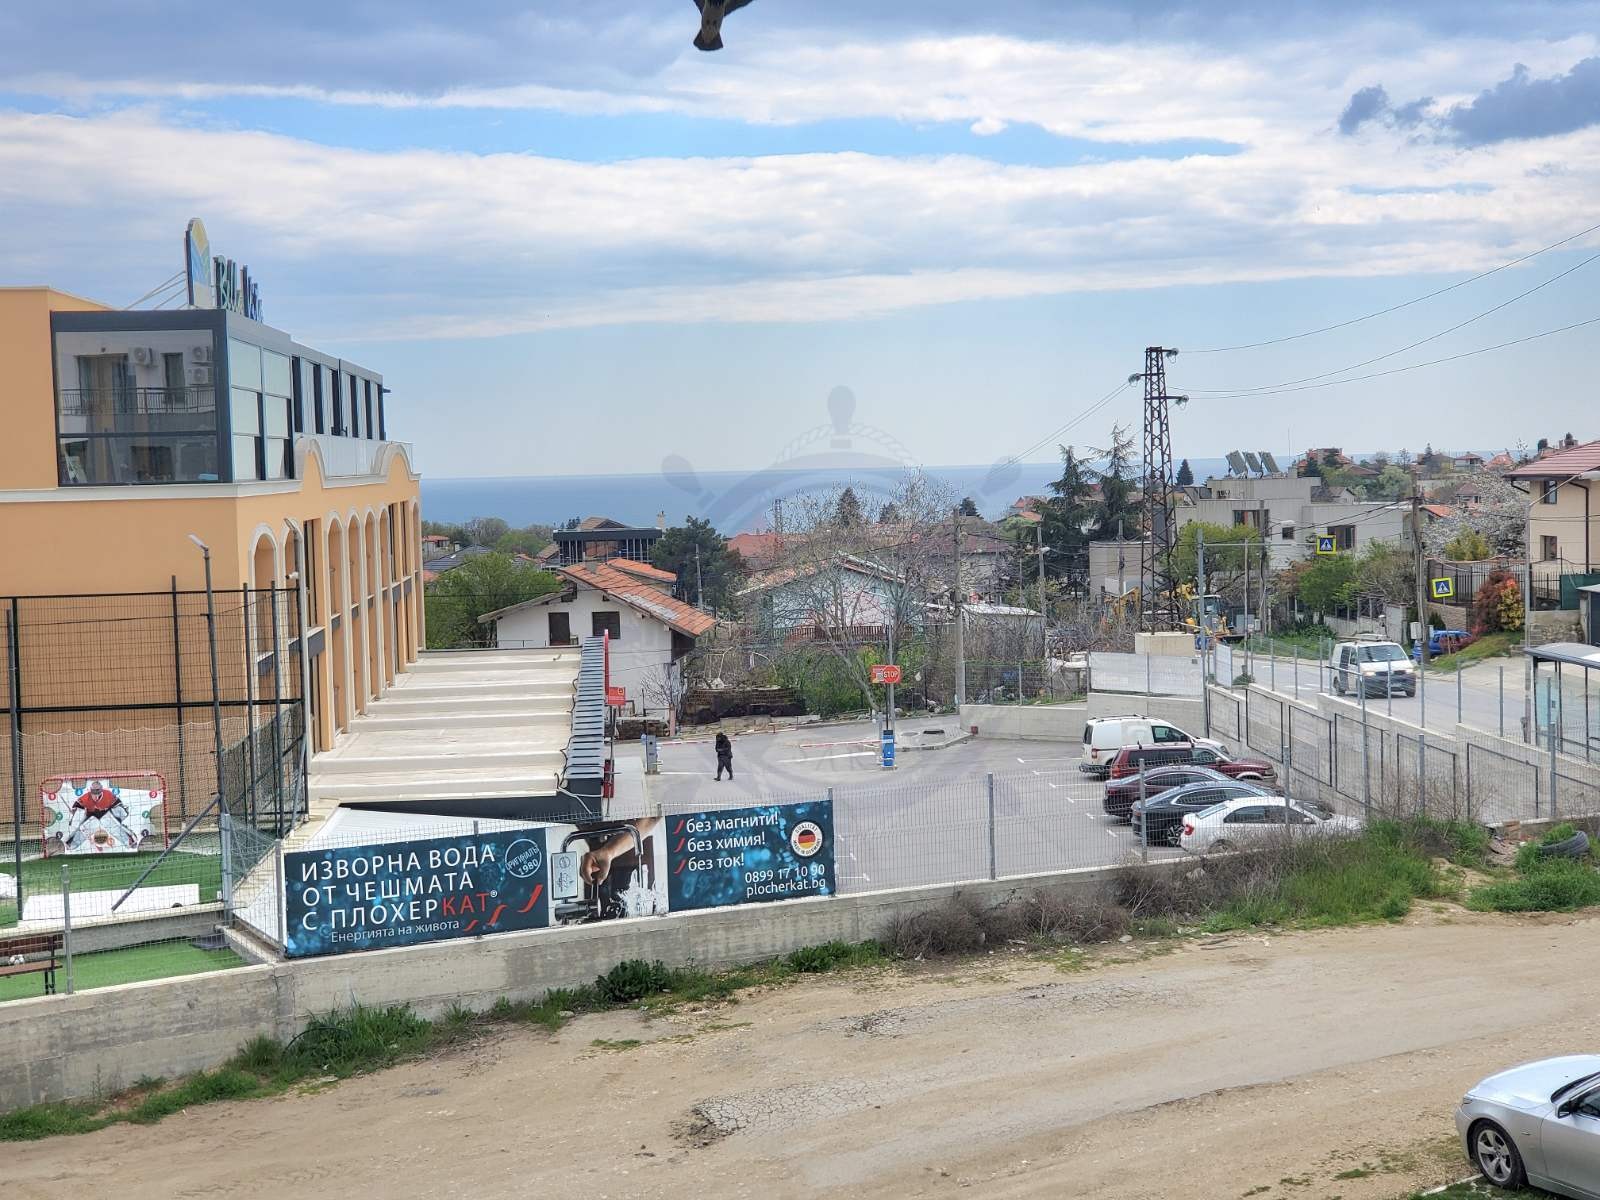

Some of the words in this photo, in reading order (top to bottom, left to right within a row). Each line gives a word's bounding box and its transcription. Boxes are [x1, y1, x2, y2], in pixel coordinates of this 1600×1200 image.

[883, 670, 898, 679] STOP
[686, 818, 711, 833] без
[715, 811, 779, 830] магнити!
[687, 837, 712, 853] без
[716, 831, 766, 850] химия!
[302, 852, 421, 882] ИЗВОРНА
[429, 844, 496, 869] ВОДА
[518, 858, 538, 875] 1980
[687, 857, 713, 872] без
[717, 852, 745, 868] ток!
[744, 870, 774, 884] 0899
[778, 868, 790, 880] 17
[795, 866, 808, 879] 10
[812, 864, 825, 876] 90
[302, 885, 337, 906] ОТ
[346, 871, 474, 902] ЧЕШМАТА
[746, 878, 826, 898] plocherkat.bg
[302, 911, 318, 930] С
[331, 927, 395, 943] Енергията
[398, 926, 412, 936] на
[415, 920, 460, 934] живота
